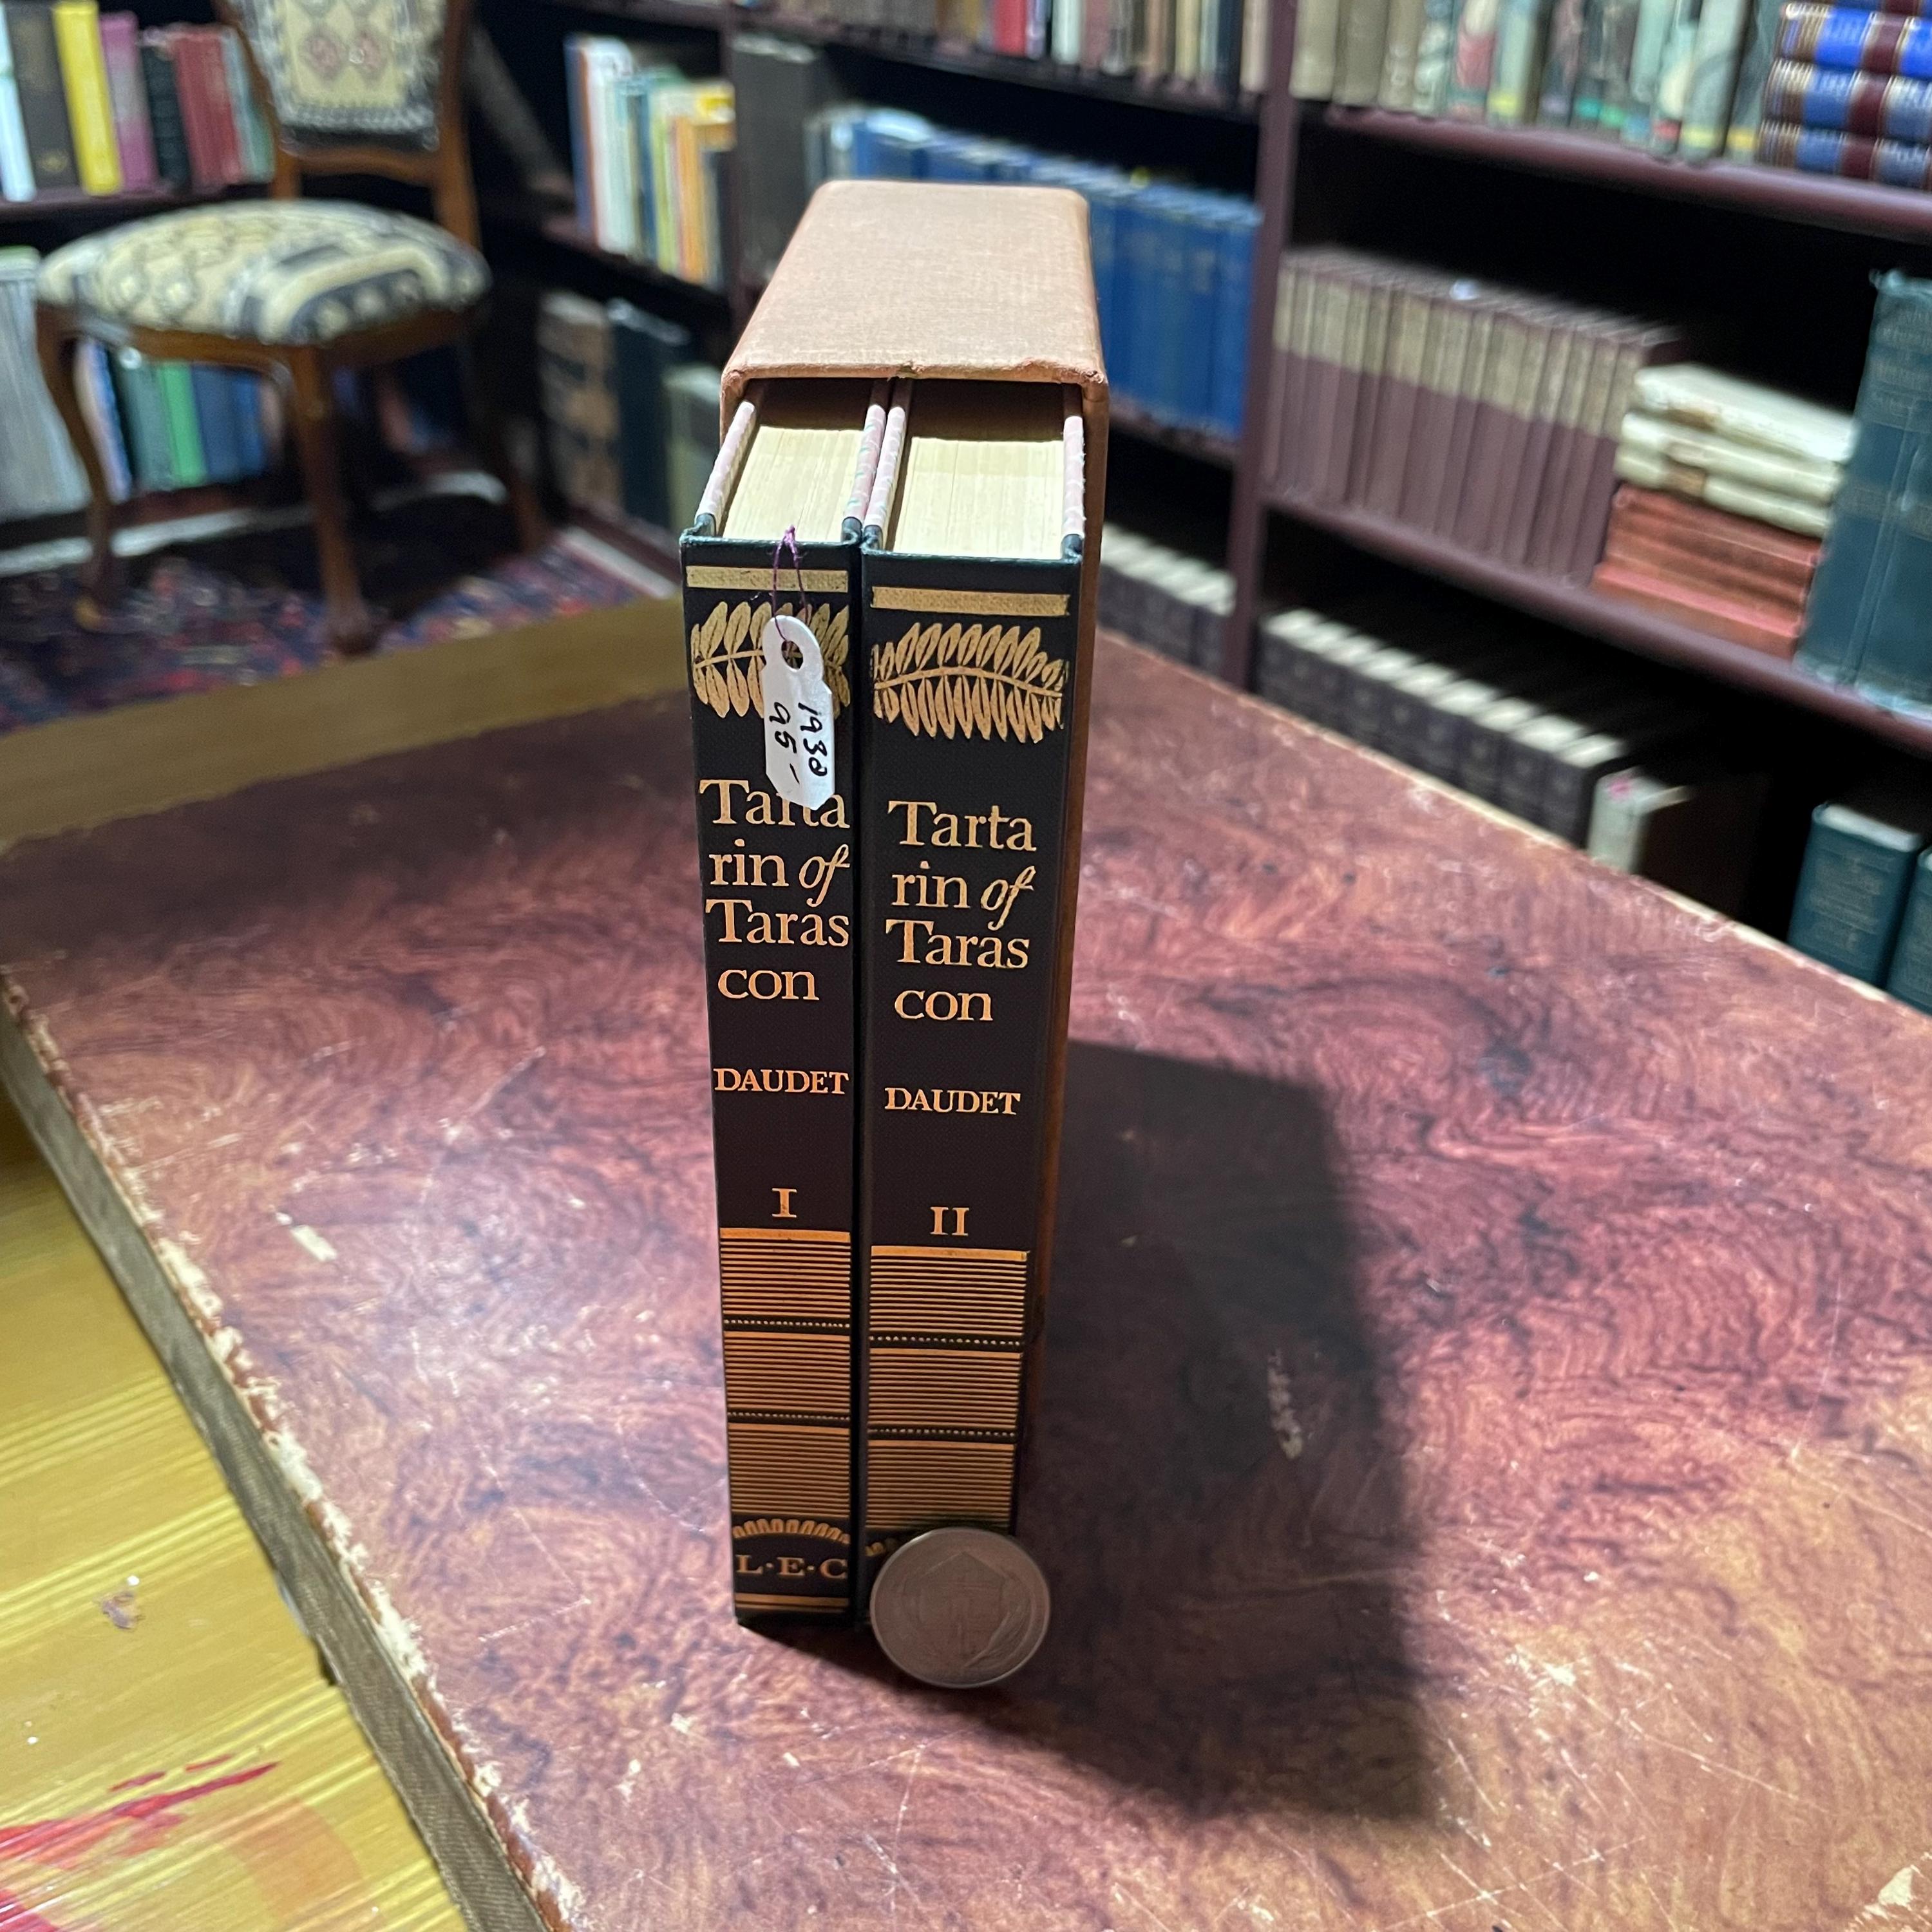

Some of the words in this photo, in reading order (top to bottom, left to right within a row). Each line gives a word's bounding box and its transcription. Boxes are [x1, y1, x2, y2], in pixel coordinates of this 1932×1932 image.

[798, 702, 828, 777] 1930
[888, 800, 1037, 852] Tarta
[709, 838, 789, 887] rin
[799, 844, 850, 907] of
[892, 861, 971, 909] rin
[980, 866, 1036, 931] of
[705, 899, 850, 947] Taras
[886, 919, 1030, 969] Taras
[717, 969, 820, 1001] con
[894, 990, 994, 1021] con
[713, 1068, 849, 1094] DAUDET
[884, 1086, 1021, 1115] DAUDET
[772, 1188, 797, 1218] I
[929, 1206, 970, 1236] II
